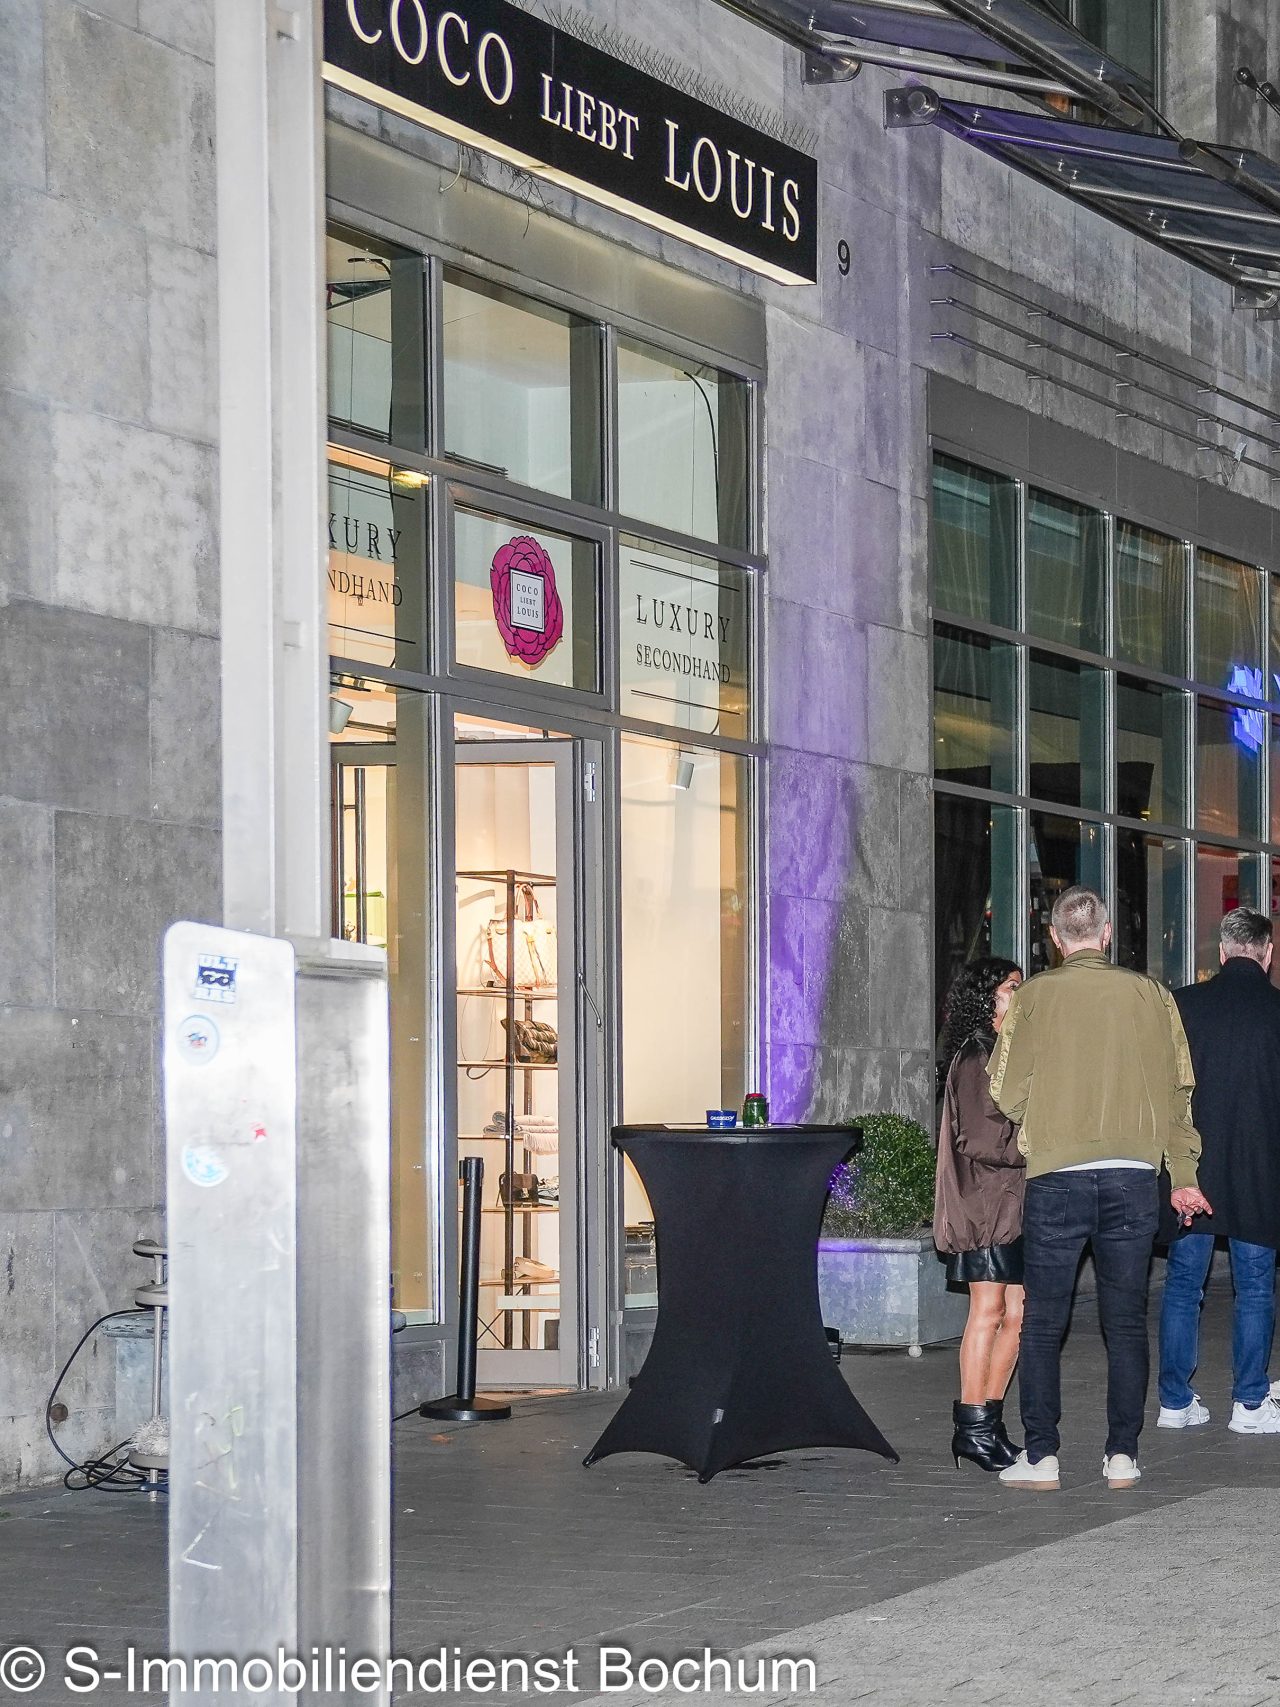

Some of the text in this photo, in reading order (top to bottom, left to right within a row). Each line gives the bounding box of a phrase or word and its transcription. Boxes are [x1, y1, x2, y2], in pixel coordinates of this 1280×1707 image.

[347, 0, 801, 242] COCO LIEBT LOUIS
[837, 239, 851, 276] 9
[516, 583, 539, 596] COCO
[520, 596, 537, 607] LIEBT
[517, 606, 539, 619] LOUIS
[636, 593, 731, 644] LUXURY
[636, 643, 731, 684] SECONDHAND
